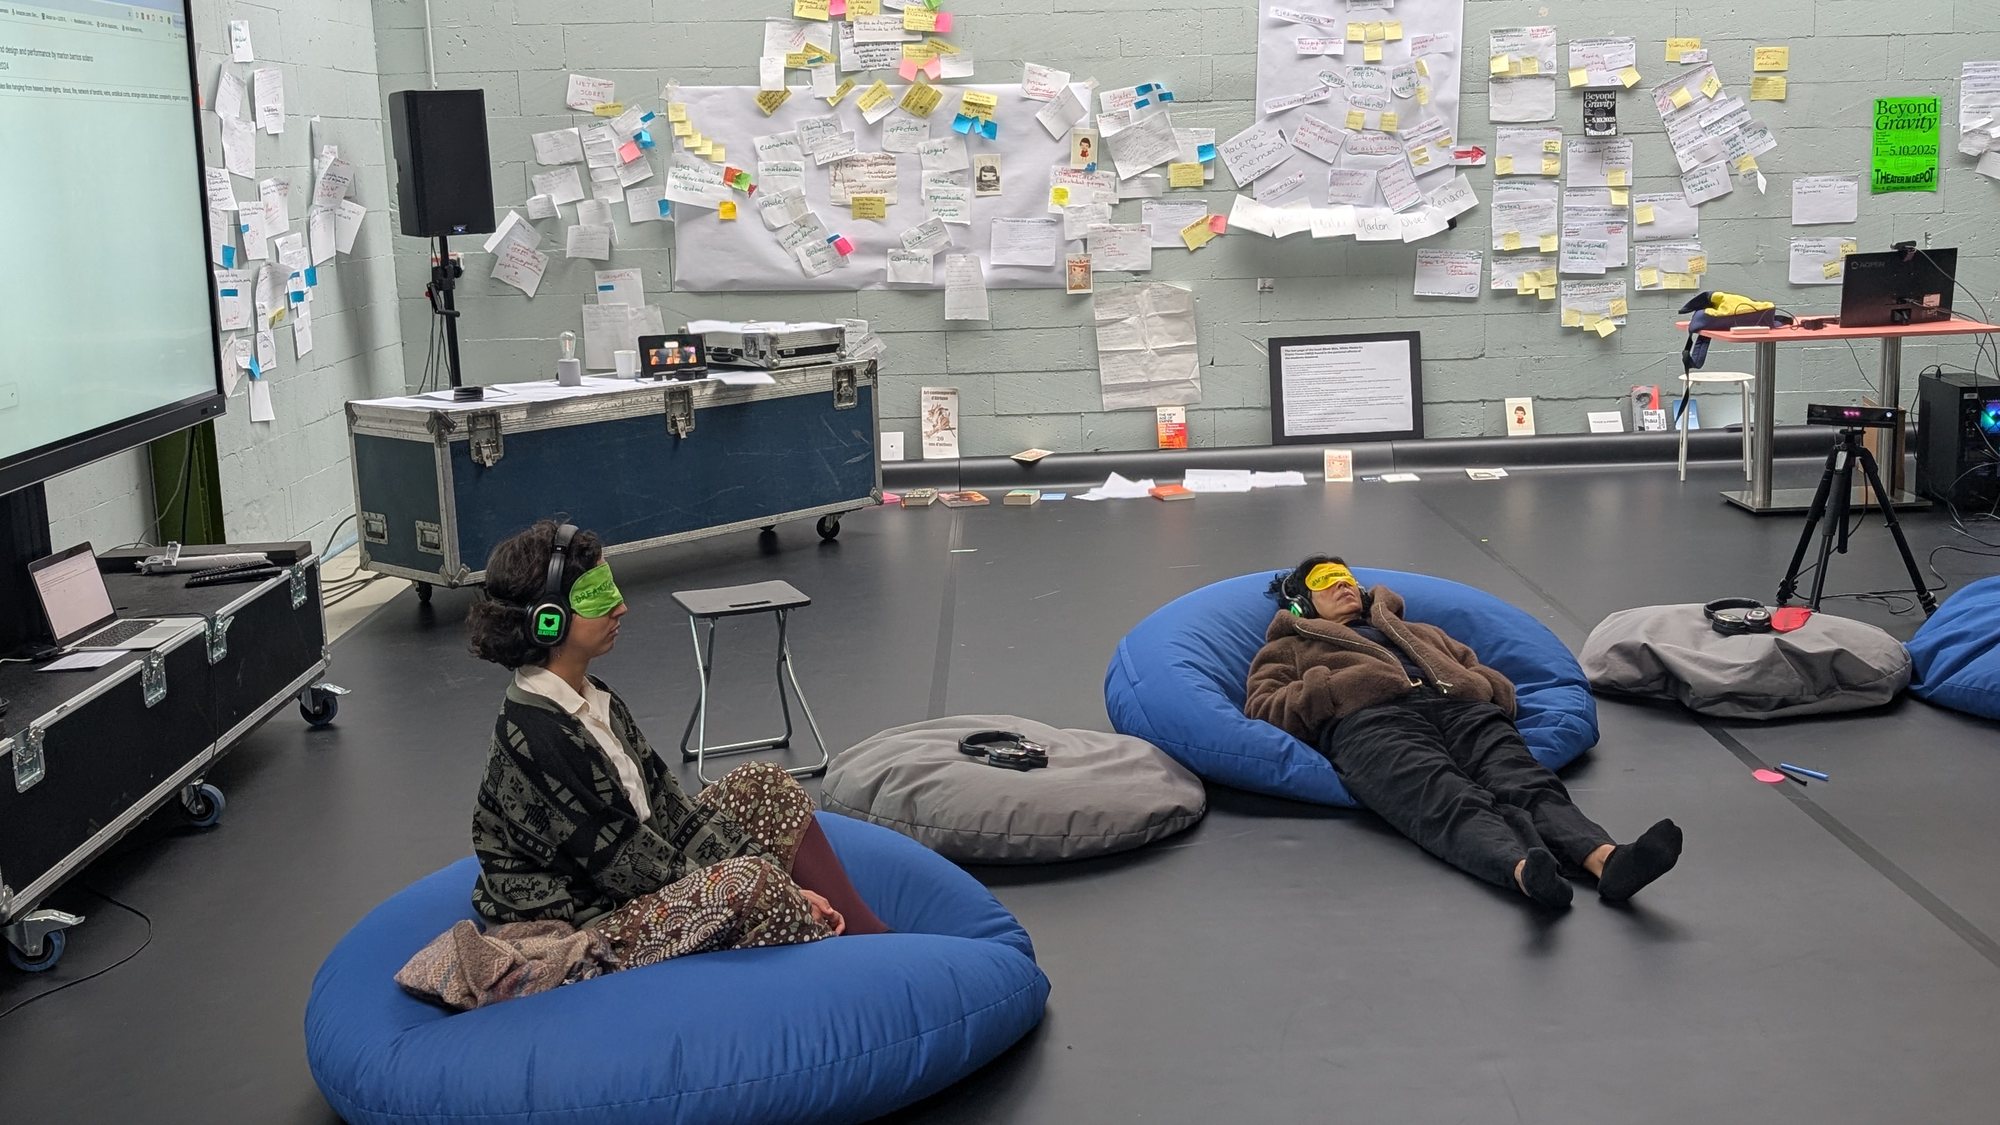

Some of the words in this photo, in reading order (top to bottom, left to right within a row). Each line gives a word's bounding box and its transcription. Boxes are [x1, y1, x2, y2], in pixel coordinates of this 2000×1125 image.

[1584, 100, 1615, 109] Gravity
[1585, 92, 1615, 101] Beyond
[1877, 98, 1937, 118] Beyond
[1875, 113, 1937, 133] Gravity
[1874, 168, 1904, 184] THEATER
[1912, 167, 1935, 184] DEPOT
